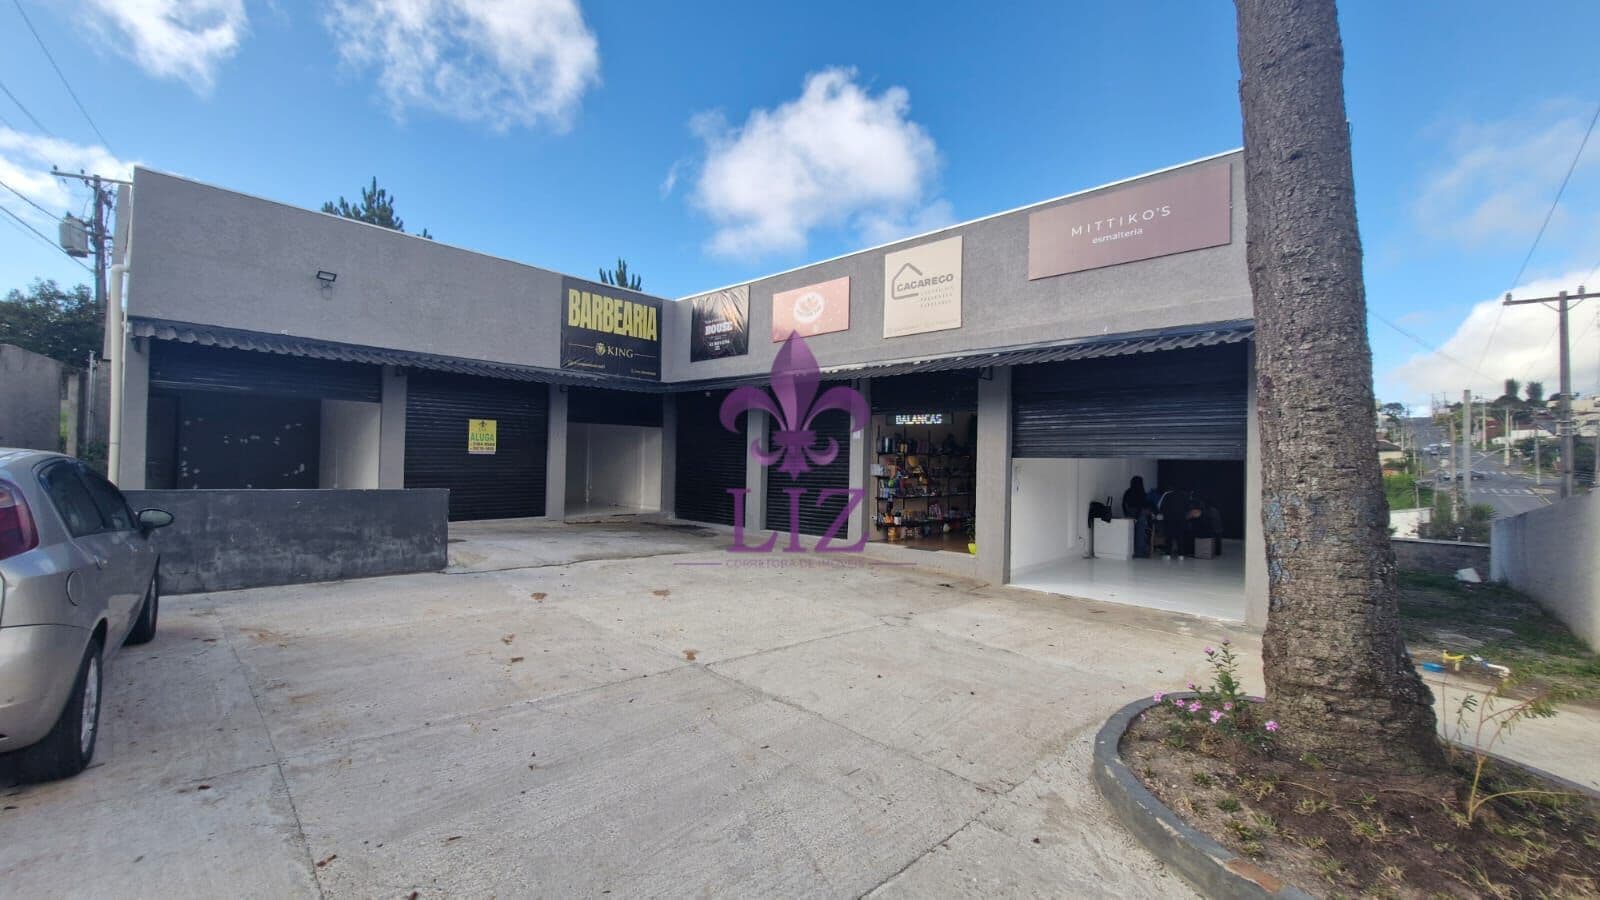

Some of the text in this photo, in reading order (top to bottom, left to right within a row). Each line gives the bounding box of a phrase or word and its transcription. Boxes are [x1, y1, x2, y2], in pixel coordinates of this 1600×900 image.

[1071, 205, 1171, 237] MITTIKO'S
[567, 288, 658, 342] BARBEARIA
[607, 345, 634, 359] KING
[470, 432, 495, 442] ALUGA
